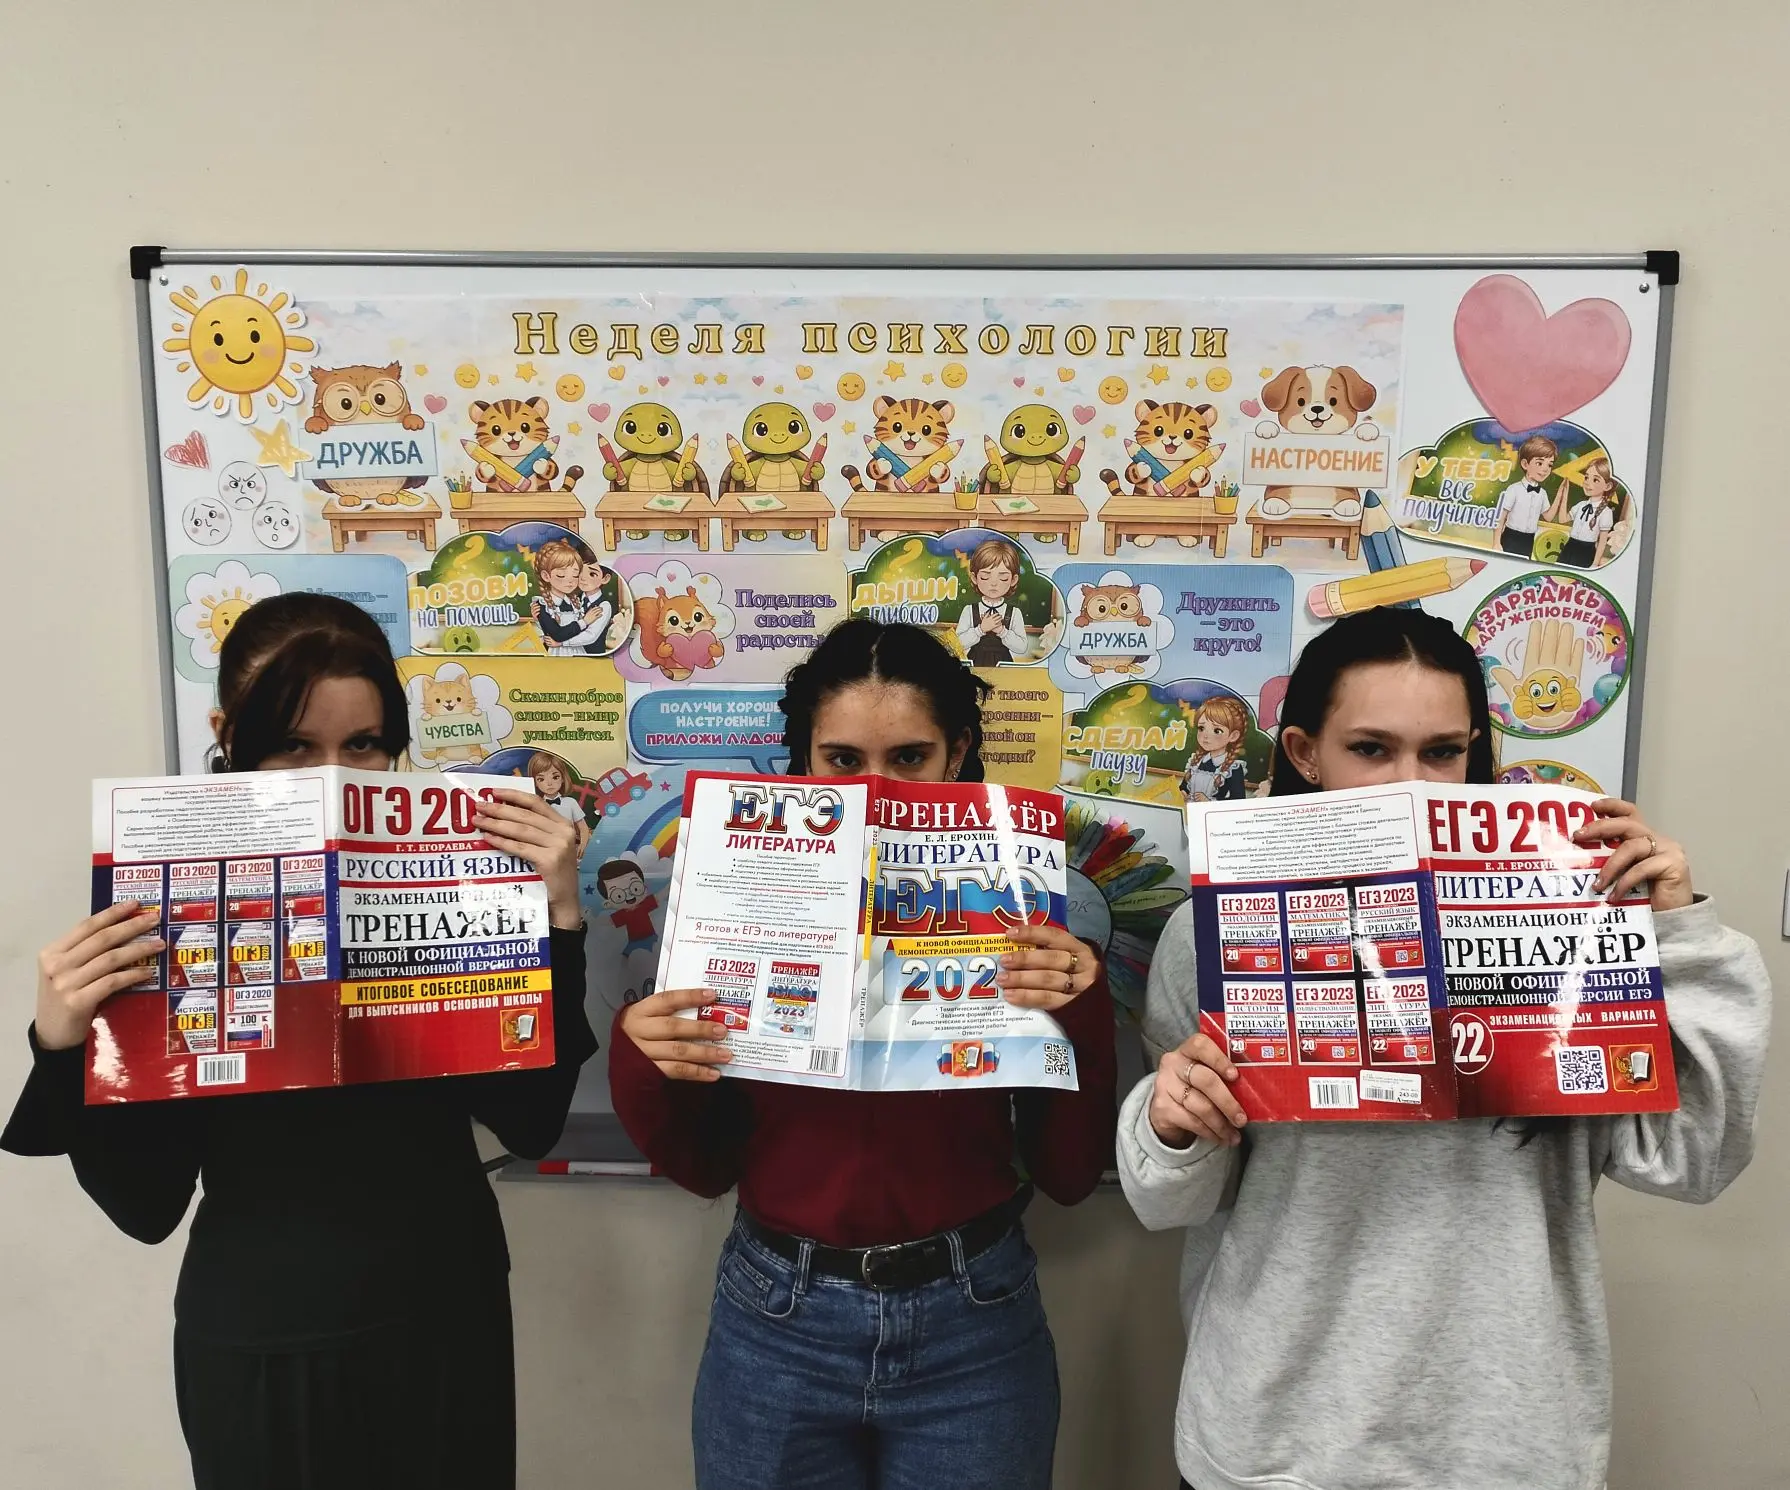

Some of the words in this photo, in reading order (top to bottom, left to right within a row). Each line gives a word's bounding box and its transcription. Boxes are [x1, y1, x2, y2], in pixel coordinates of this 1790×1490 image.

[512, 312, 765, 361] Неделя
[801, 322, 1228, 358] психологии
[317, 440, 423, 469] ДРУЖБА
[1250, 447, 1384, 473] НАСТРОЕНИЕ
[1415, 456, 1438, 478] У
[1441, 457, 1512, 482] ТЕБЯ
[409, 572, 528, 609] ПОЗОВИ
[852, 576, 958, 612] ДЫШИ
[735, 589, 836, 610] Поделись
[1176, 592, 1280, 615] Дружить
[1479, 585, 1600, 626] ЗАРЯДИСЬ
[754, 610, 815, 628] своей
[1218, 617, 1254, 631] это
[1479, 606, 1605, 646] ДРУЖЕЛЮБИЕМ
[1080, 632, 1147, 649] ДРУЖБА
[1193, 634, 1262, 656] круто!
[509, 688, 566, 702] Скажи
[566, 688, 623, 706] доброе
[998, 690, 1049, 701] твоего
[660, 702, 722, 714] ПОЛУЧИ
[514, 711, 560, 721] слово
[586, 711, 619, 725] мир
[676, 713, 770, 728] НАСТРОЕНИЕ!
[426, 723, 484, 739] ЧУВСТВА
[523, 726, 614, 743] улыбнётся.
[1015, 732, 1035, 742] он
[1063, 720, 1188, 753] СДЕЛАЙ
[646, 732, 722, 746] ПРИЛОЖИ
[726, 732, 786, 745] ЛАДОШ
[343, 783, 412, 836] ОГЭ
[724, 783, 845, 836] ЕГЭ
[1428, 799, 1499, 853] ЕГЭ
[726, 834, 836, 854] ЛИТЕРАТУРА
[925, 835, 934, 843] Е.
[936, 834, 947, 843] Л.
[950, 833, 999, 842] ЕРОХИН
[407, 844, 417, 852] Т.
[419, 843, 473, 852] ЕГОРАЕВА
[172, 866, 191, 877] ОГЭ
[192, 865, 216, 876] 2020
[228, 863, 246, 874] ОГЭ
[248, 862, 272, 873] 2020
[283, 860, 299, 871] ОГЭ
[301, 858, 323, 869] 2020
[346, 854, 455, 879] РУССКИЙ
[463, 855, 536, 876] ЯЗЫК
[1485, 862, 1494, 871] Е.
[1497, 862, 1507, 871] Л.
[115, 869, 134, 880] ОГЭ
[135, 868, 160, 879] 2020
[878, 865, 1051, 933] ЕГЭ
[1289, 895, 1312, 909] ЕГЭ
[1314, 893, 1345, 908] 2023
[1359, 890, 1381, 905] ЕГЭ
[1383, 887, 1415, 903] 2023
[172, 905, 182, 914] 20
[229, 902, 239, 911] 20
[285, 900, 295, 909] 20
[1221, 899, 1243, 911] ЕГЭ
[1245, 897, 1276, 911] 2023
[1290, 912, 1346, 920] МАТЕМАТИКА
[695, 921, 702, 931] Я
[704, 924, 731, 934] готов
[734, 926, 740, 934] к
[742, 925, 761, 936] ЕГЭ
[763, 929, 776, 938] по
[778, 930, 837, 943] литературе!
[1224, 929, 1277, 938] ТРЕНАЖЁР
[1292, 924, 1347, 937] ТРЕНАЖЁР
[290, 941, 317, 958] ОГЭ
[923, 939, 949, 947] НОВОЙ
[950, 937, 1010, 946] ОФИЦИАЛЬНОЙ
[1442, 927, 1646, 968] ТРЕНАЖЁР
[177, 948, 205, 965] ОГЭ
[233, 945, 261, 962] ОГЭ
[359, 946, 408, 964] НОВОЙ
[415, 938, 539, 962] ОФИЦИАЛЬНОЙ
[897, 947, 981, 956] ДЕМОНСТРАЦИОННОЙ
[984, 945, 1015, 953] ВЕРСИИ
[1226, 949, 1238, 960] 20
[1295, 947, 1308, 960] 20
[347, 961, 463, 979] ДЕМОНСТРАЦИОННОЙ
[469, 960, 514, 971] ВЕРСИИ
[519, 957, 540, 967] ОГЭ
[707, 958, 728, 972] ЕГЭ
[728, 960, 756, 974] 2023
[772, 965, 819, 976] ТРЕНАЖЁР
[357, 983, 414, 1001] ИТОГОВОЕ
[420, 975, 529, 998] СОБЕСЕДОВАНИЕ
[1454, 973, 1504, 991] НОВОЙ
[235, 990, 251, 1000] ОГЭ
[252, 989, 272, 998] 2020
[1226, 988, 1249, 1001] ЕГЭ
[1251, 988, 1283, 1001] 2023
[1296, 988, 1318, 1001] ЕГЭ
[1321, 987, 1354, 1000] 2023
[1392, 983, 1426, 998] 2023
[1629, 989, 1652, 1000] ЕГЭ
[348, 1006, 363, 1019] ДЛЯ
[366, 1001, 439, 1017] ВЫПУСКНИКОВ
[444, 995, 499, 1012] ОСНОВНОЙ
[503, 993, 543, 1006] ШКОЛЫ
[701, 1006, 712, 1016] 22
[774, 1004, 805, 1017] 2023
[178, 1013, 205, 1030] ОГЭ
[241, 1015, 257, 1024] 100
[1229, 1018, 1286, 1028] ТРЕНАЖЁР
[1299, 1018, 1356, 1028] ТРЕНАЖЁР
[1601, 1009, 1656, 1022] ВАРИАНТА
[1232, 1040, 1245, 1051] 20
[1302, 1040, 1315, 1051] 20
[1373, 1040, 1386, 1051] 22
[1452, 1022, 1487, 1063] 22
